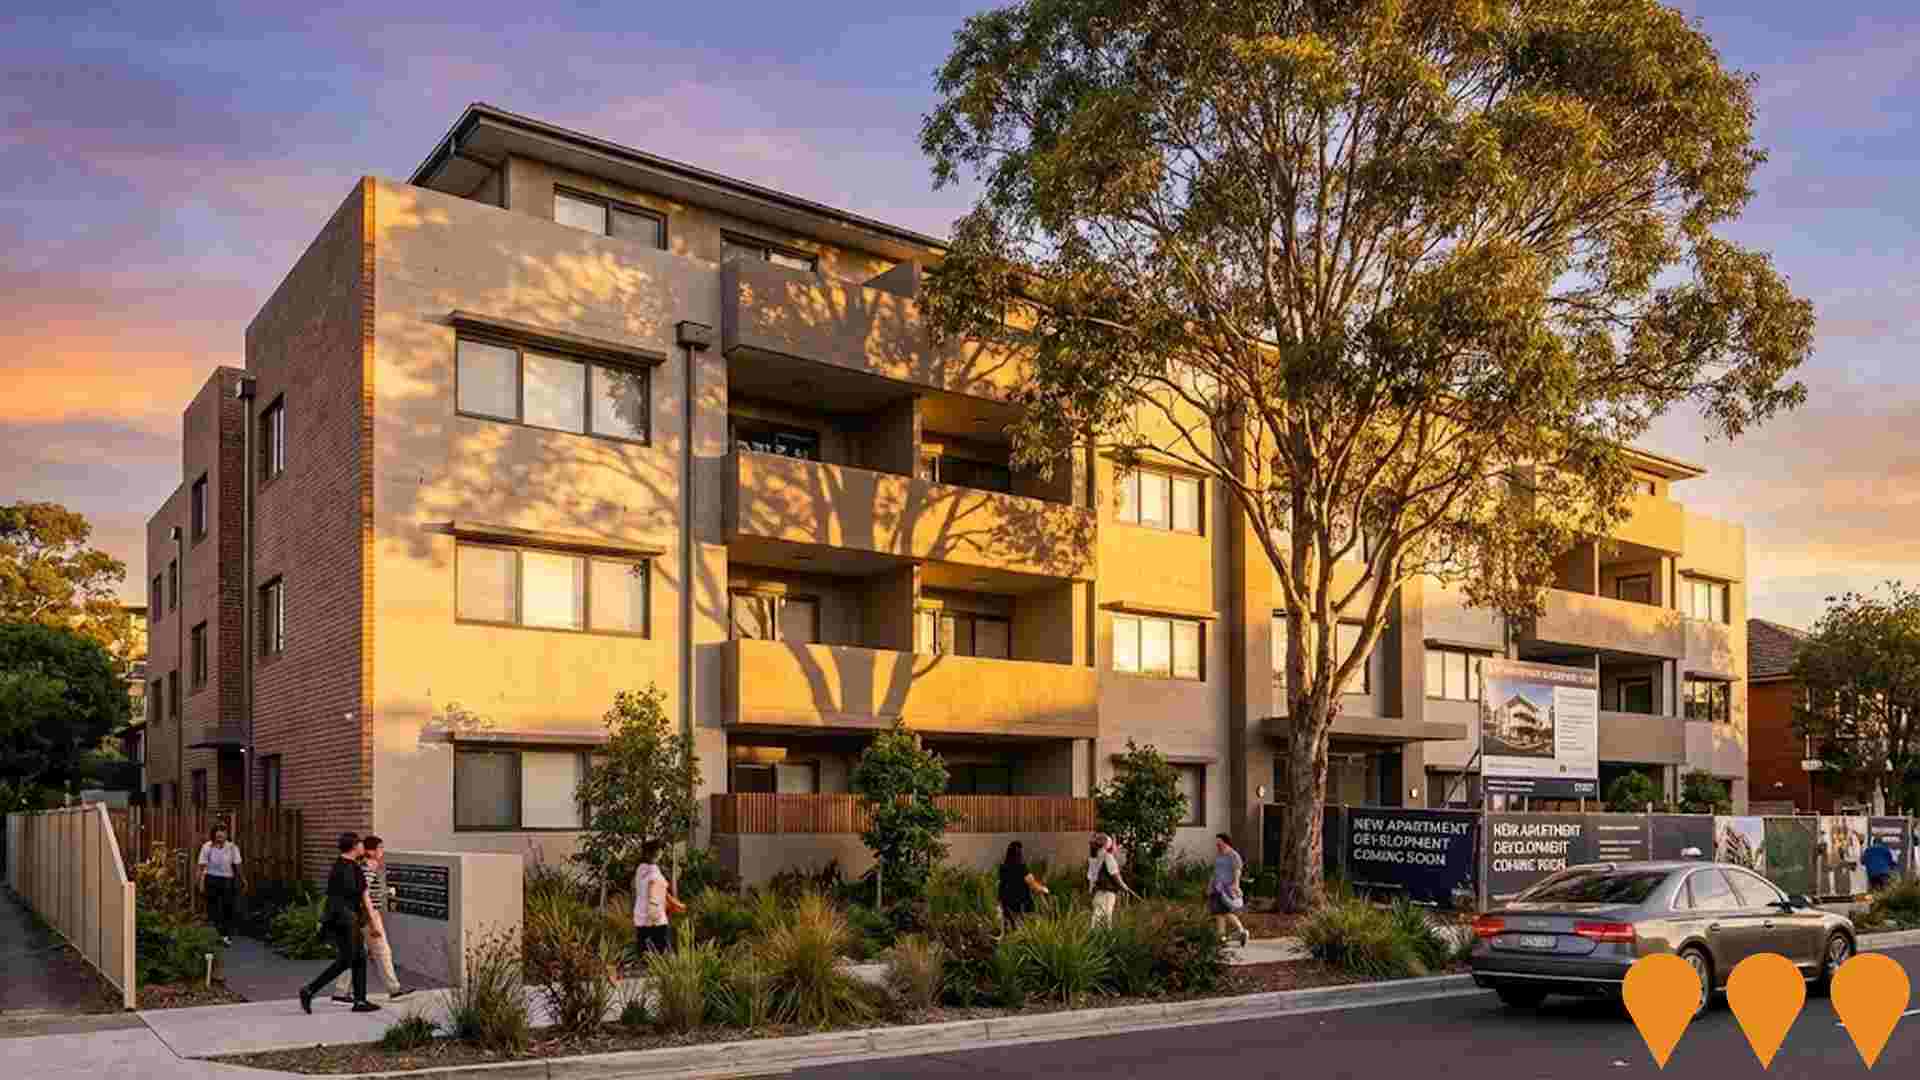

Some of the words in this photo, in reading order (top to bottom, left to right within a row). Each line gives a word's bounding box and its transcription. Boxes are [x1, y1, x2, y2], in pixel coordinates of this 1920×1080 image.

[1353, 818, 1384, 831] NEW
[1386, 820, 1470, 835] APARTMENT
[1406, 850, 1447, 866] SOON
